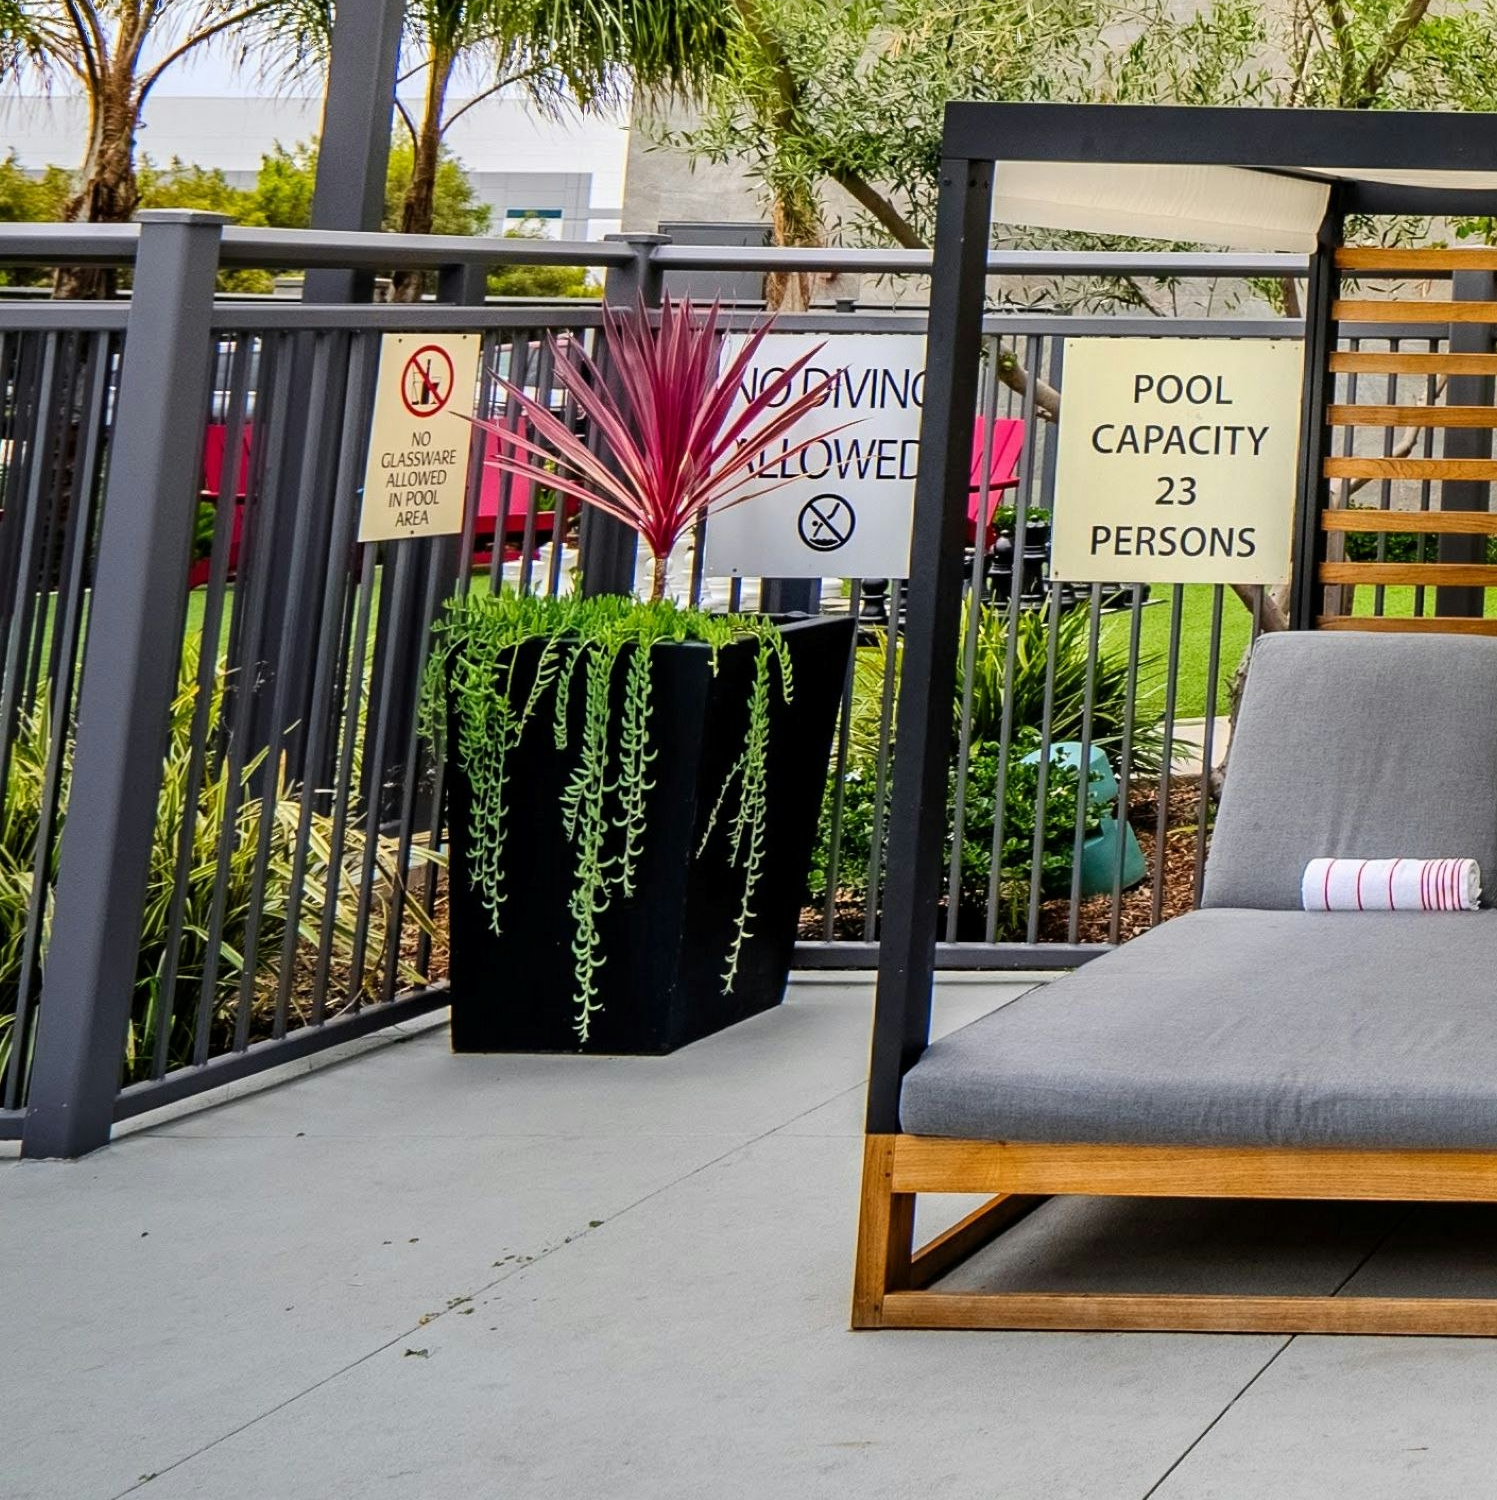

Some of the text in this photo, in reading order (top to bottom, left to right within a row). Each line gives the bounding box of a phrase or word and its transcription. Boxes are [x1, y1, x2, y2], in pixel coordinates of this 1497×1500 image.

[1133, 374, 1233, 405] POOL
[411, 431, 431, 447] NO
[1091, 423, 1270, 456] CAPACITY
[381, 449, 457, 468] GLASSWARE
[385, 469, 447, 488] ALLOWED
[388, 489, 440, 508] IN POOL
[1154, 476, 1197, 506] 23
[395, 510, 429, 527] AREA
[1090, 525, 1256, 558] PERSONS
